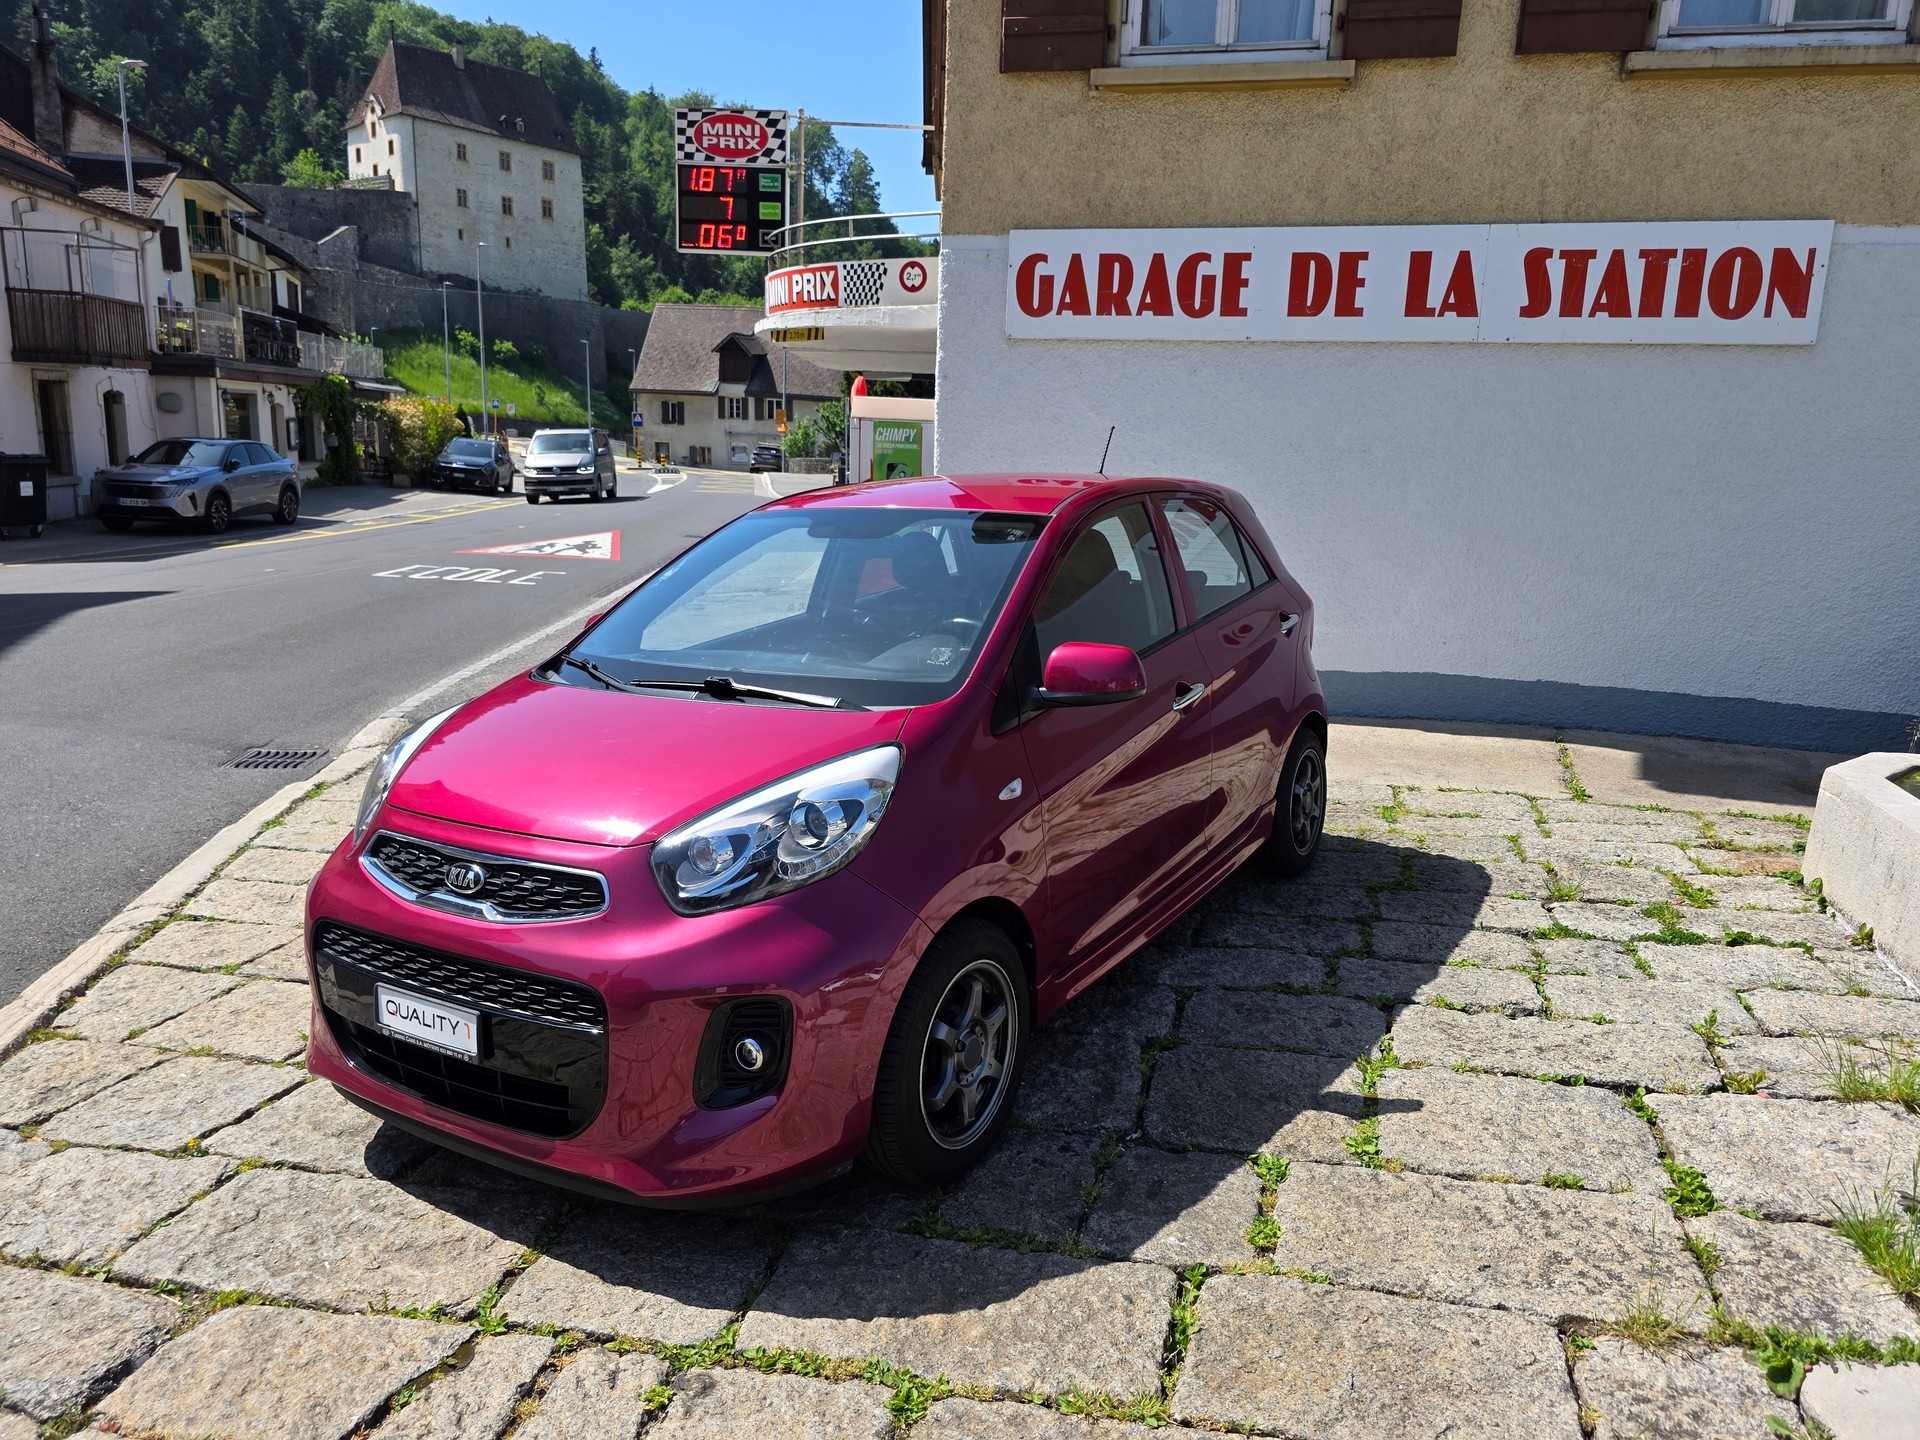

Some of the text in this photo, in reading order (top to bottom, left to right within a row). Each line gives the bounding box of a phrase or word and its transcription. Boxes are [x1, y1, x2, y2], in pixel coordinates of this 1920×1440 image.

[702, 122, 761, 137] MINI
[702, 136, 761, 150] PRIX
[768, 270, 837, 308] MINI PRIX
[1015, 246, 1818, 321] GARAGE DE LA STATION
[875, 427, 918, 443] CHIMPY
[371, 564, 567, 586] ECOLE
[448, 867, 475, 889] KIA
